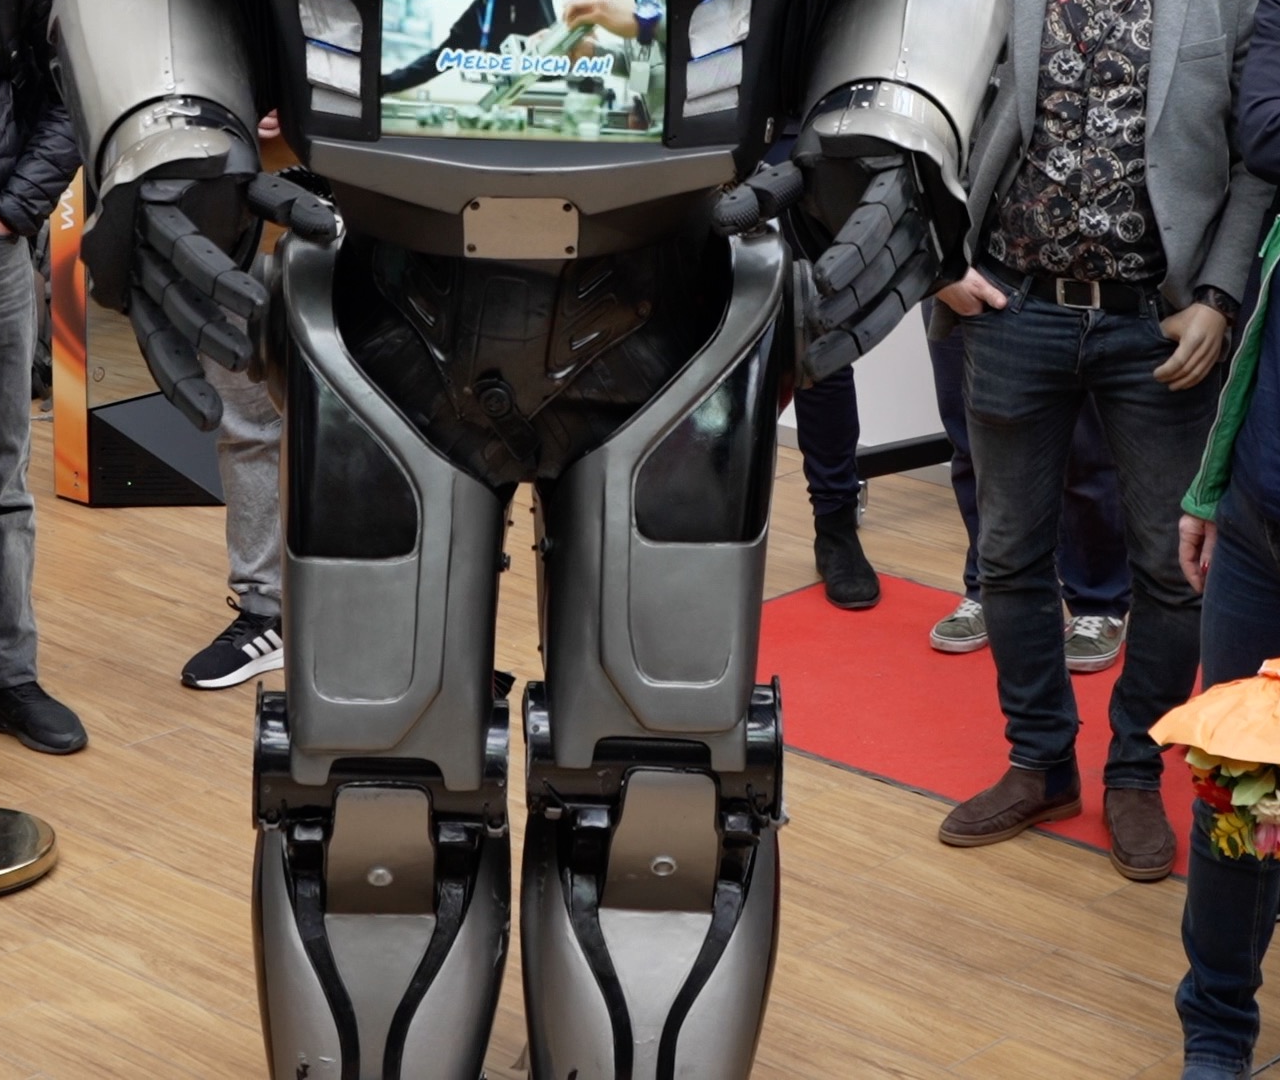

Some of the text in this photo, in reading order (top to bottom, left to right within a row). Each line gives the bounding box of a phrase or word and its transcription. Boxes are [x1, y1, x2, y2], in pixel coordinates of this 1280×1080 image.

[437, 50, 614, 74] MELDE DICH AN!
